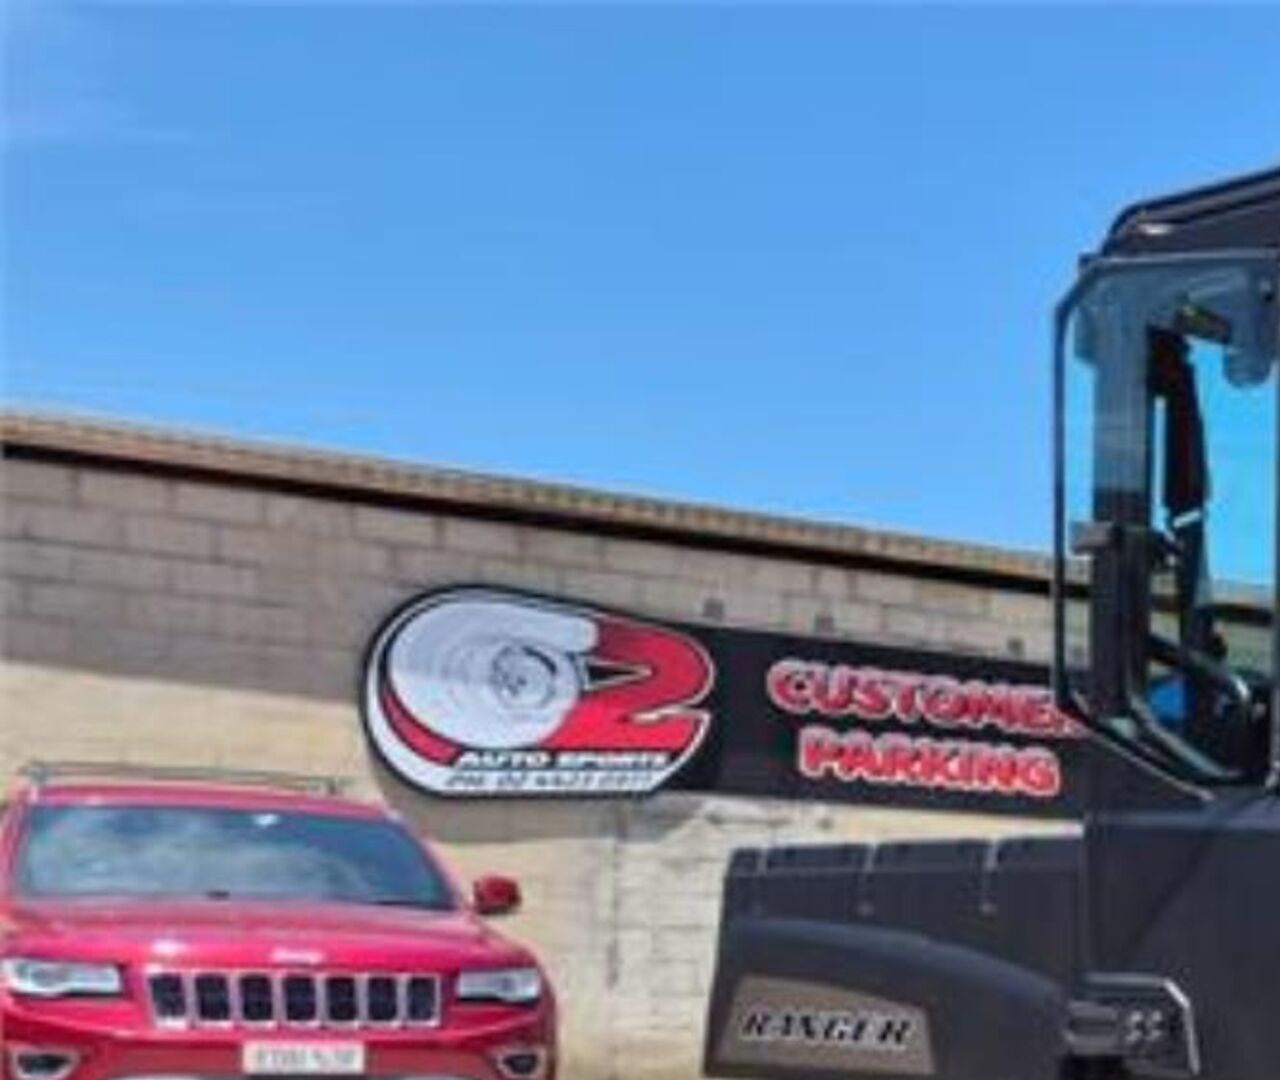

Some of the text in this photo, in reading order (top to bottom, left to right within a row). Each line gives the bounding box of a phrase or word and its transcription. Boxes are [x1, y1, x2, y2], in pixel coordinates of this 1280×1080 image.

[453, 751, 673, 771] AUTO SPORTS
[798, 725, 1062, 797] PARKING
[740, 1011, 913, 1047] RANGER
